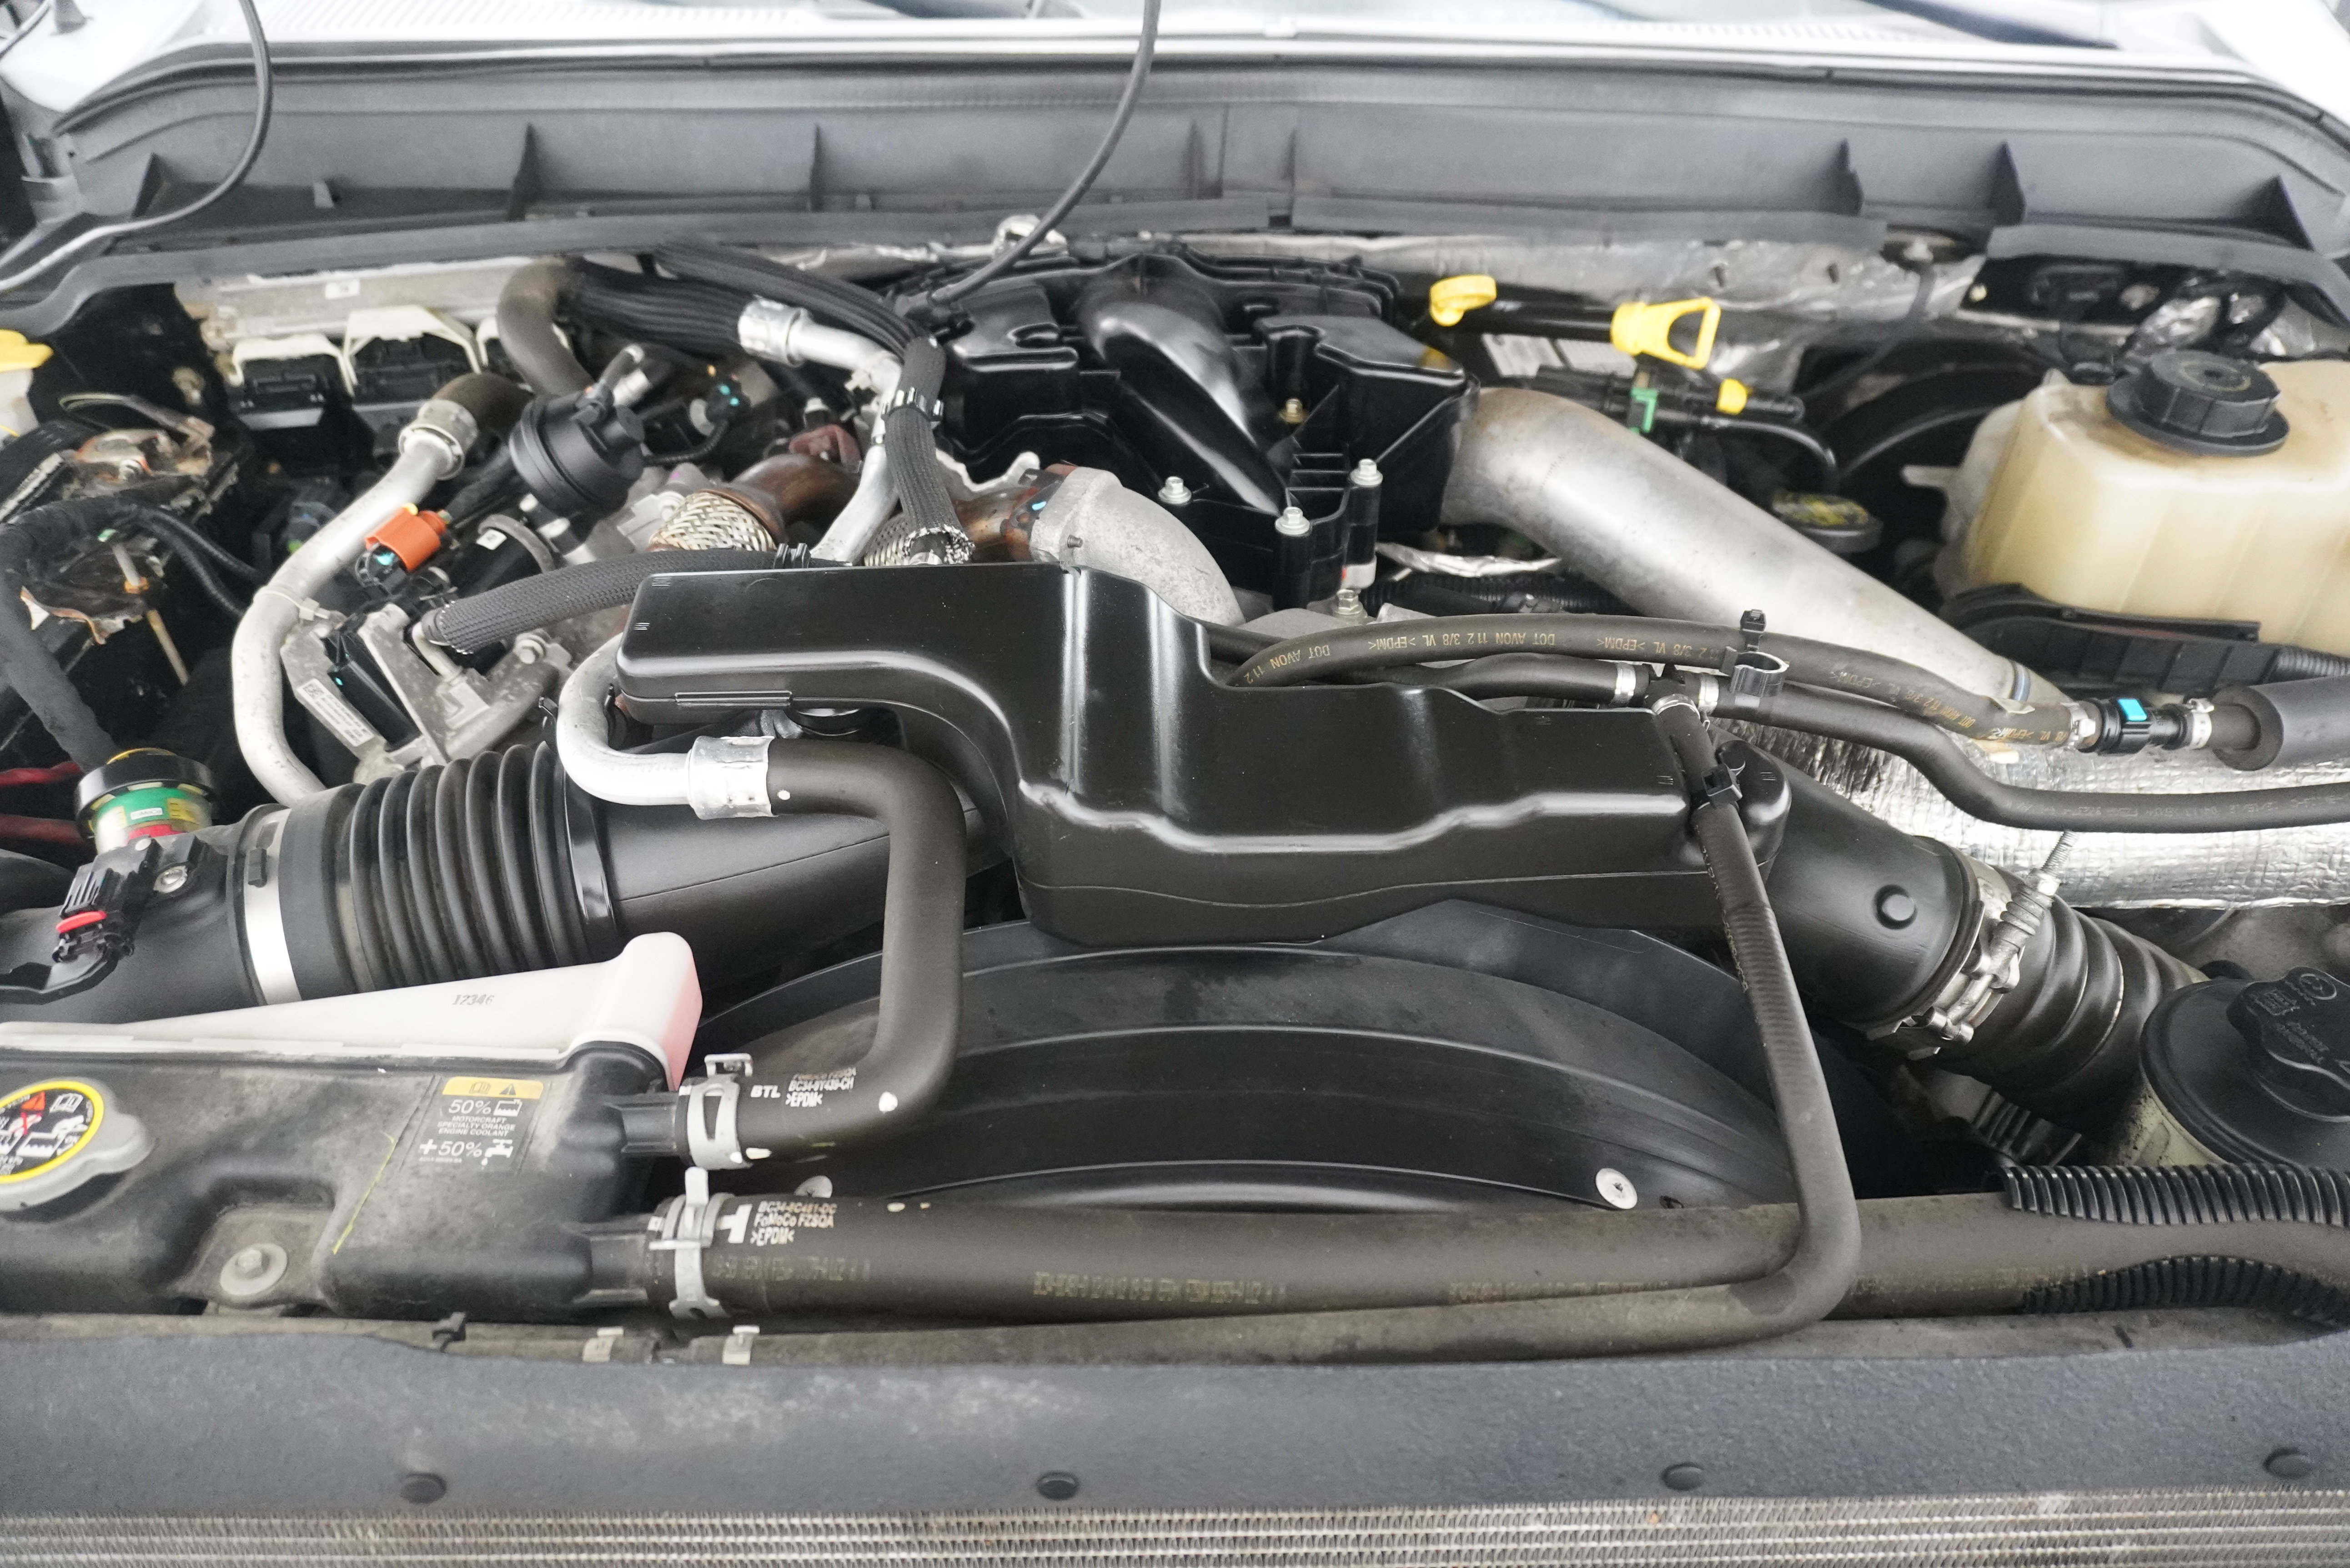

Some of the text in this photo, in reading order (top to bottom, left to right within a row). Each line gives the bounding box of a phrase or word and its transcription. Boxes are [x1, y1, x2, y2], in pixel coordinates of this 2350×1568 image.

[1442, 633, 1461, 646] 3/8
[1495, 633, 1526, 645] AVON
[1308, 644, 1330, 659] DOT
[1270, 649, 1301, 669] AVON
[750, 1085, 781, 1098] BTL
[448, 1099, 492, 1115] 50%
[437, 1121, 516, 1131] SPECIALTY ORANGE
[452, 1116, 508, 1124] MOTORCRAFT
[470, 1129, 509, 1137] COOLANT
